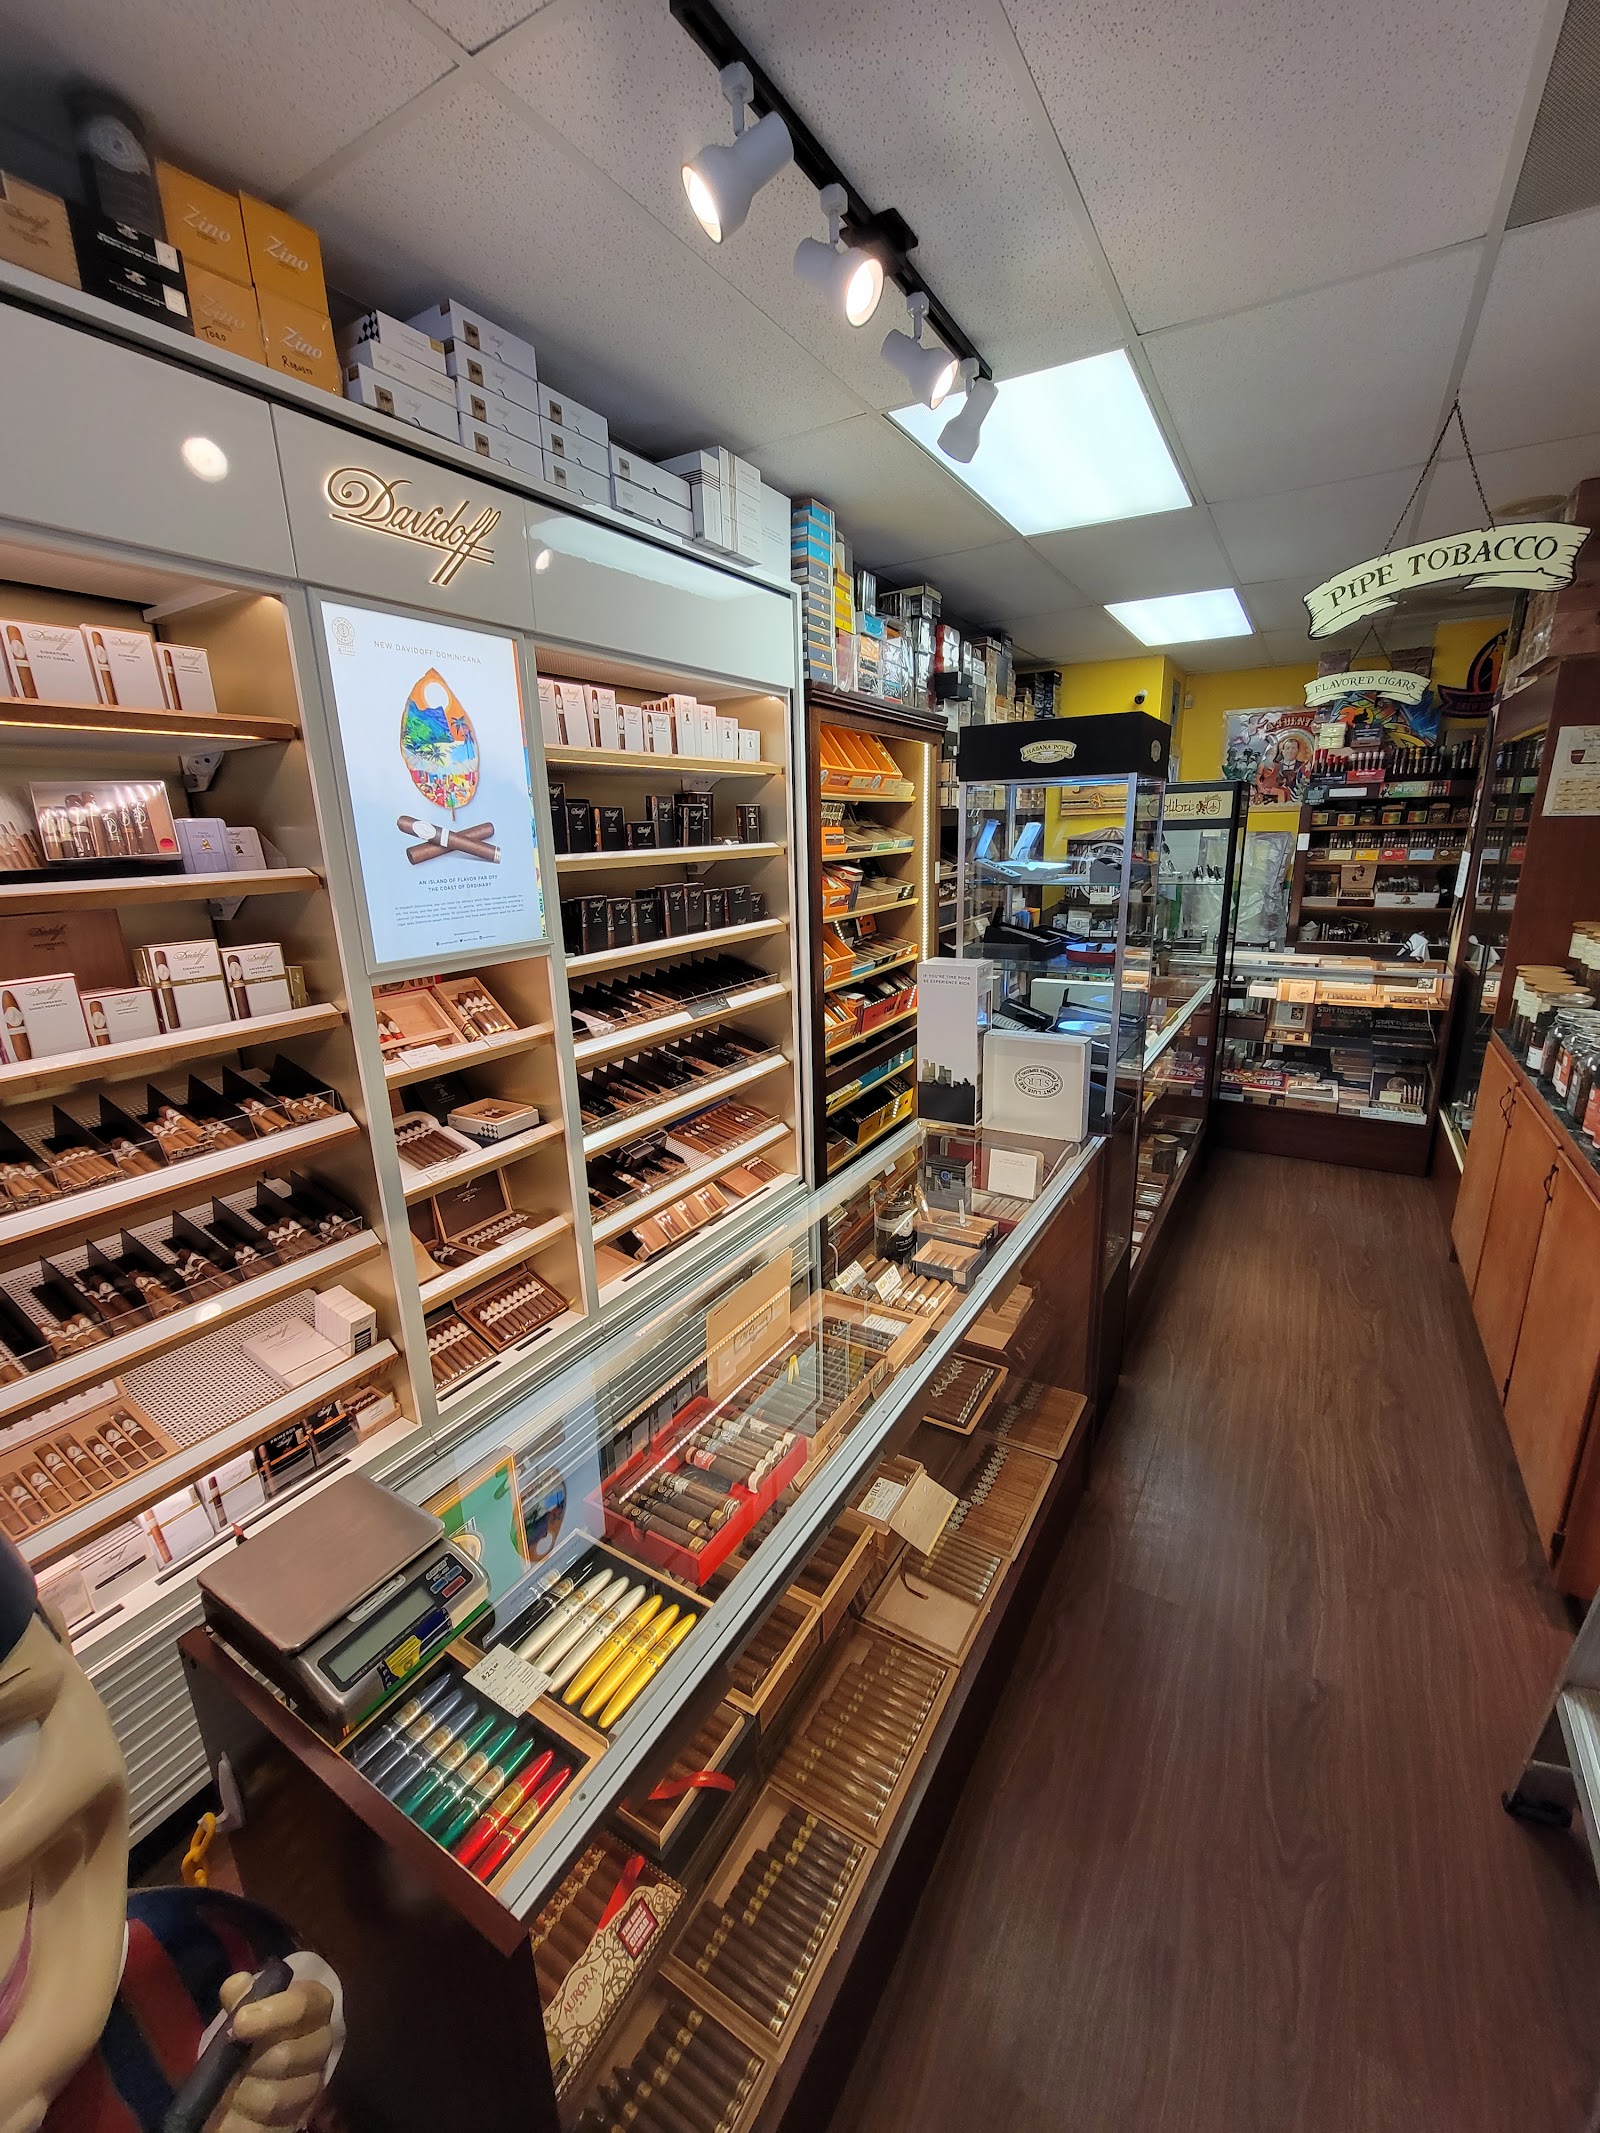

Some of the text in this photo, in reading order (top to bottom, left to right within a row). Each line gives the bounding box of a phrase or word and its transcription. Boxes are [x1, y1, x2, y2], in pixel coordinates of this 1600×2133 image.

[183, 205, 232, 244] Zino
[266, 236, 309, 272] Zino
[198, 296, 246, 330] Zino
[281, 327, 323, 360] Zino
[325, 467, 502, 586] Davidoff
[1323, 536, 1559, 609] PIPE TOBACCO
[27, 629, 75, 651] Davidoff
[374, 640, 482, 664] NEW DAVIDOFF DOMINICANA
[1314, 675, 1418, 694] FLAVORED CIGARS
[1276, 716, 1313, 728] FUENT
[1026, 745, 1051, 754] HABANA
[174, 947, 210, 965] Davidoff
[270, 1427, 296, 1444] PRIMEROS
[629, 1917, 650, 1947] CIGAR
[564, 1966, 599, 2021] AURORA
